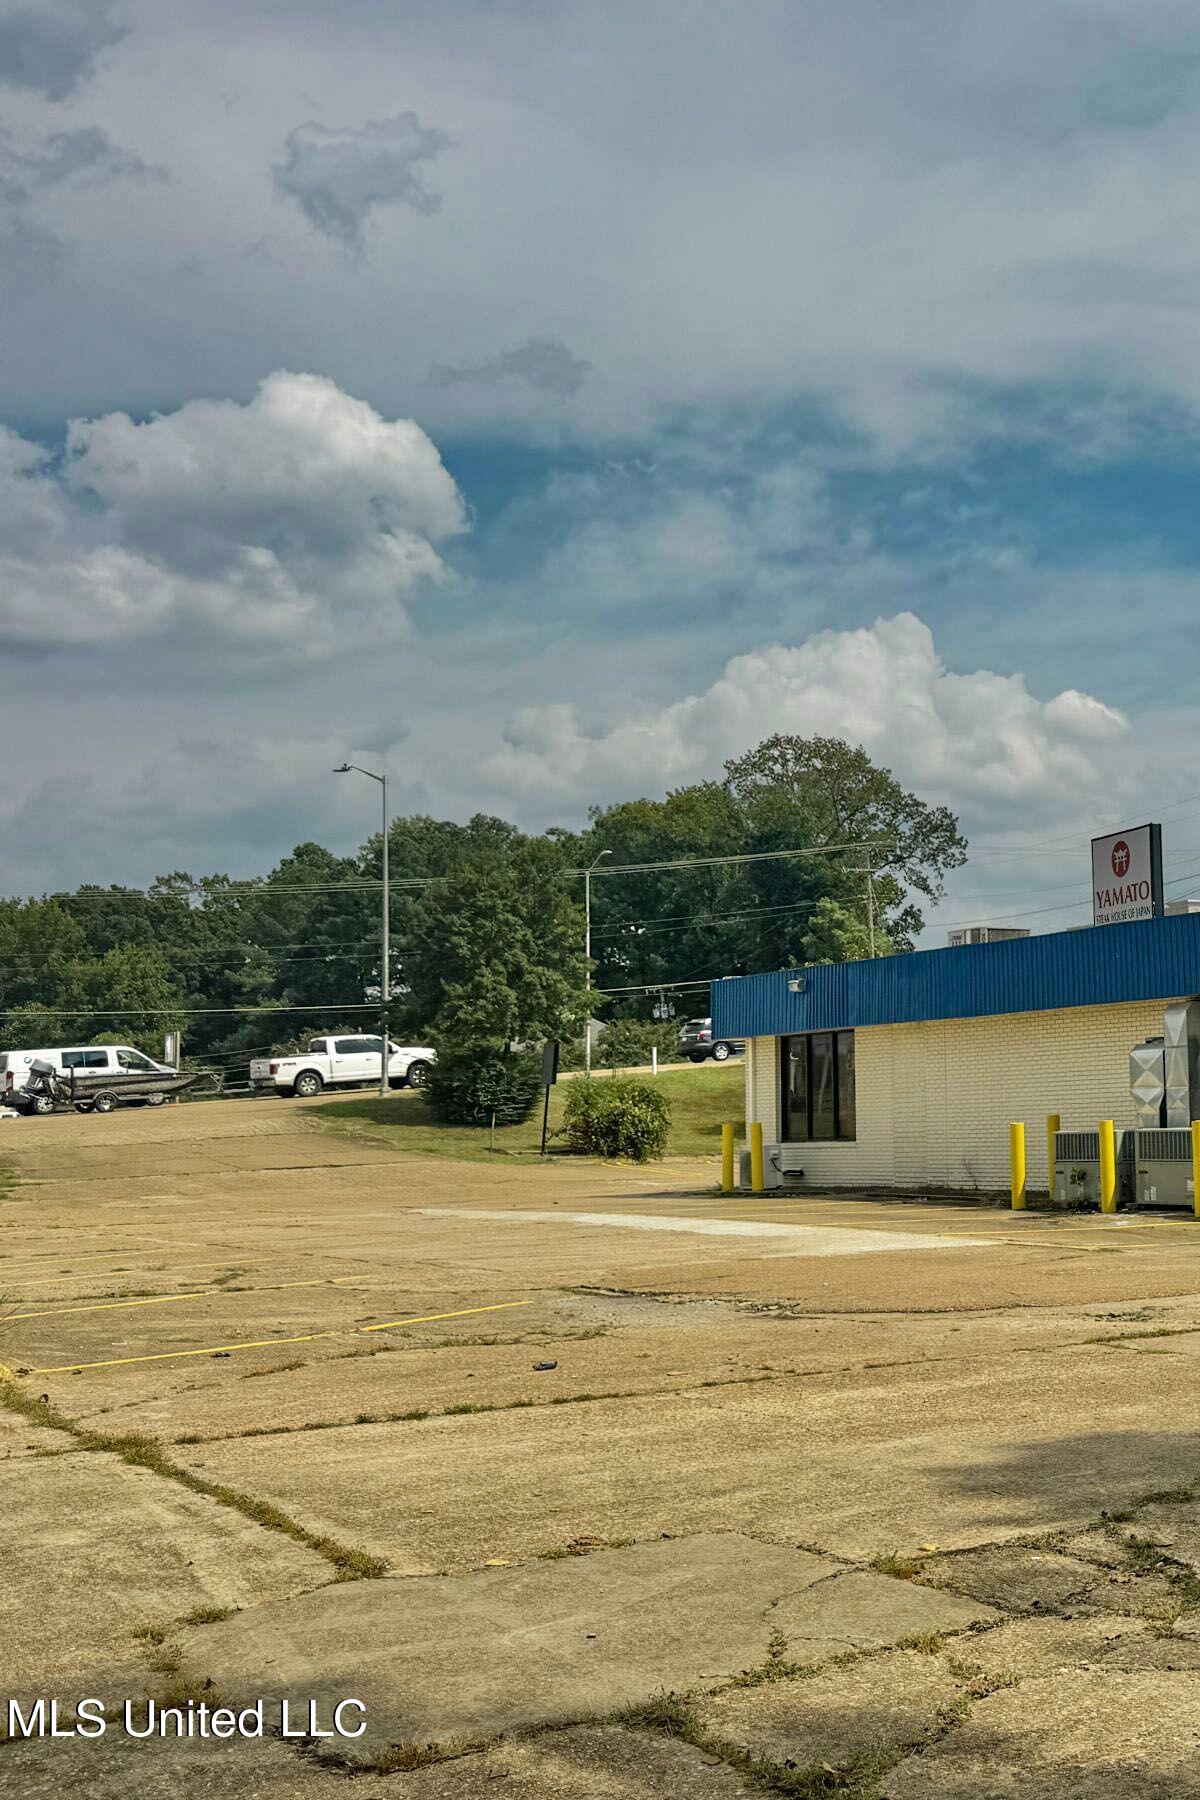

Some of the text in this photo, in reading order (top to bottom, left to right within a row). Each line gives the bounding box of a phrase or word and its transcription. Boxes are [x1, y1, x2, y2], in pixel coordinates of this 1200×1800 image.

[1096, 880, 1150, 909] YAMATO
[1111, 909, 1127, 922] HOUSE
[1128, 908, 1135, 919] OF
[1136, 904, 1151, 917] JAPAN
